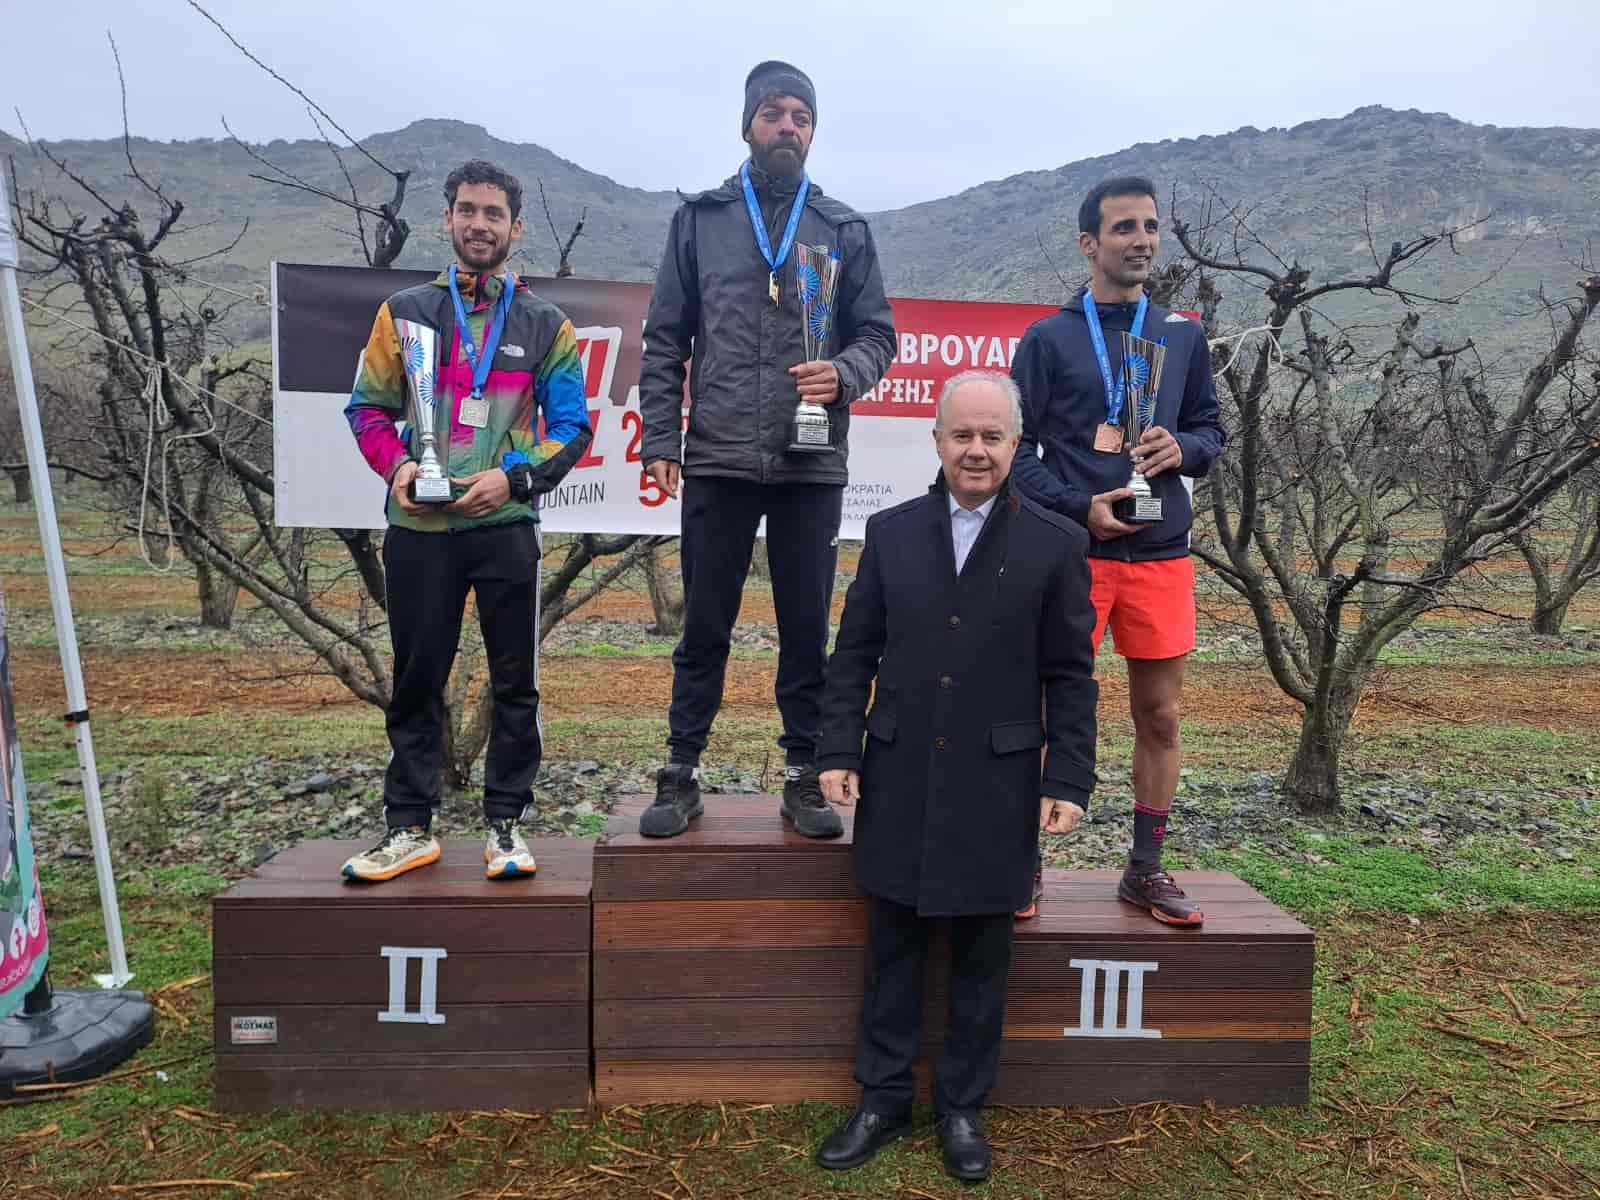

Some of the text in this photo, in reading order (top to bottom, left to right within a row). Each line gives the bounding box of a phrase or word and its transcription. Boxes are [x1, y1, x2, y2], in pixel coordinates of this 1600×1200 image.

[892, 332, 1021, 368] ΒΡΟΥΑ
[857, 378, 935, 403] ΑΡΞΗΣ
[378, 946, 448, 1024] II
[1064, 959, 1162, 1038] III
